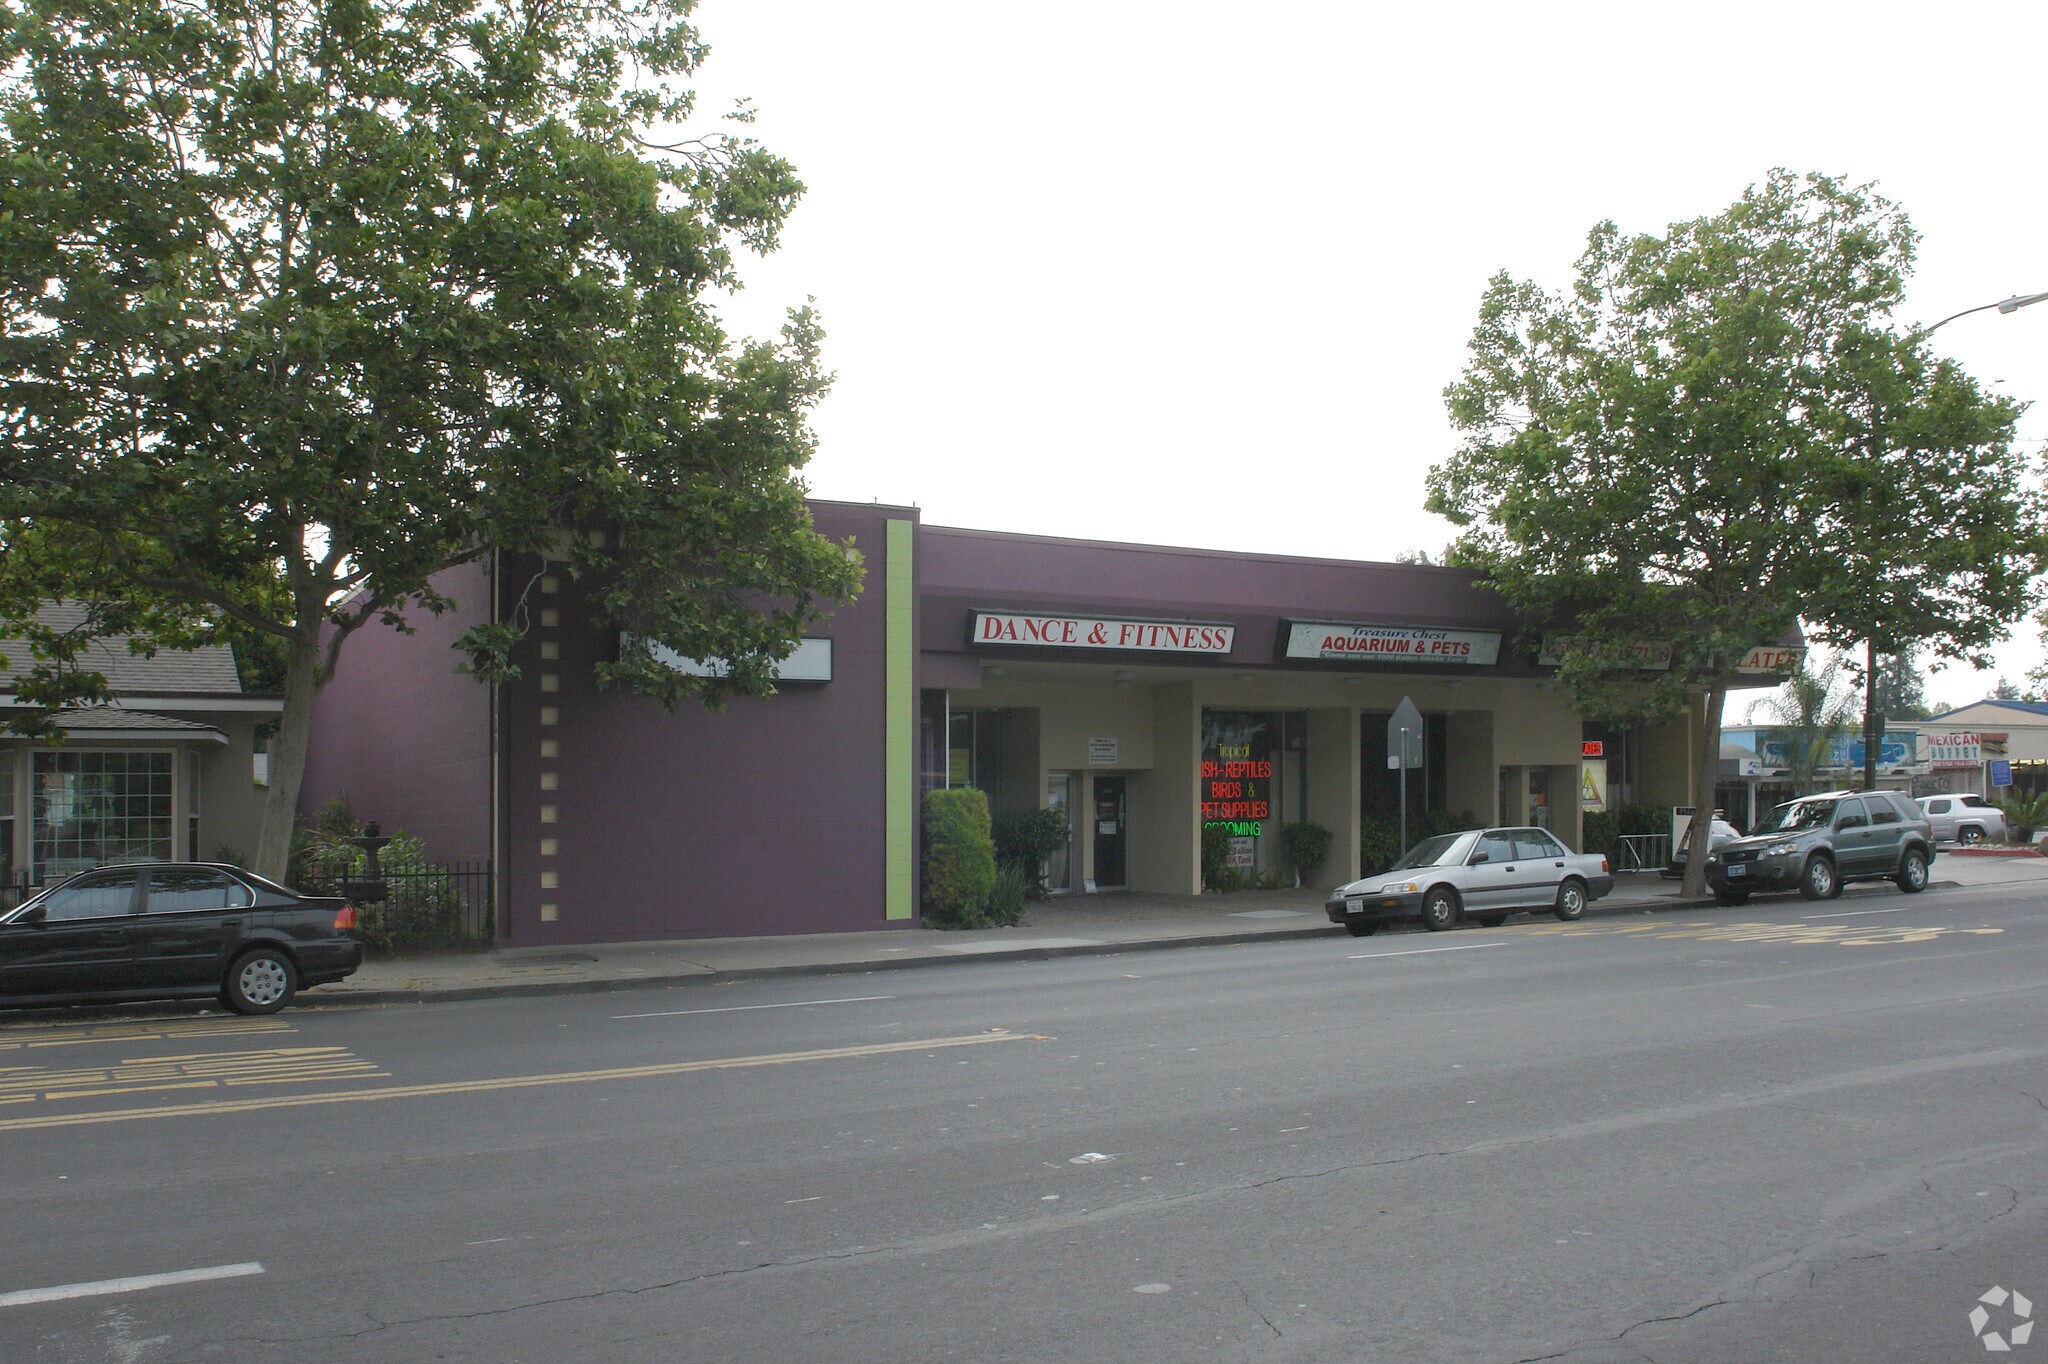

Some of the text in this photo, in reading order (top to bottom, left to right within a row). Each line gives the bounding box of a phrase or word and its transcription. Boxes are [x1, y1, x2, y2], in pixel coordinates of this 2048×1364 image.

[982, 615, 1228, 650] DANCE & FITNESS
[1351, 625, 1449, 641] Treasure Chest
[1320, 635, 1472, 656] AQUARIUM & PETS
[1928, 734, 1980, 746] MEXICAN
[1218, 743, 1250, 759] Tropical
[1931, 746, 1979, 759] BUFFET
[1201, 760, 1271, 778] ISH-REPTILES
[1211, 781, 1255, 798] BIRDS &
[1200, 801, 1268, 819] PET SUPPLIES
